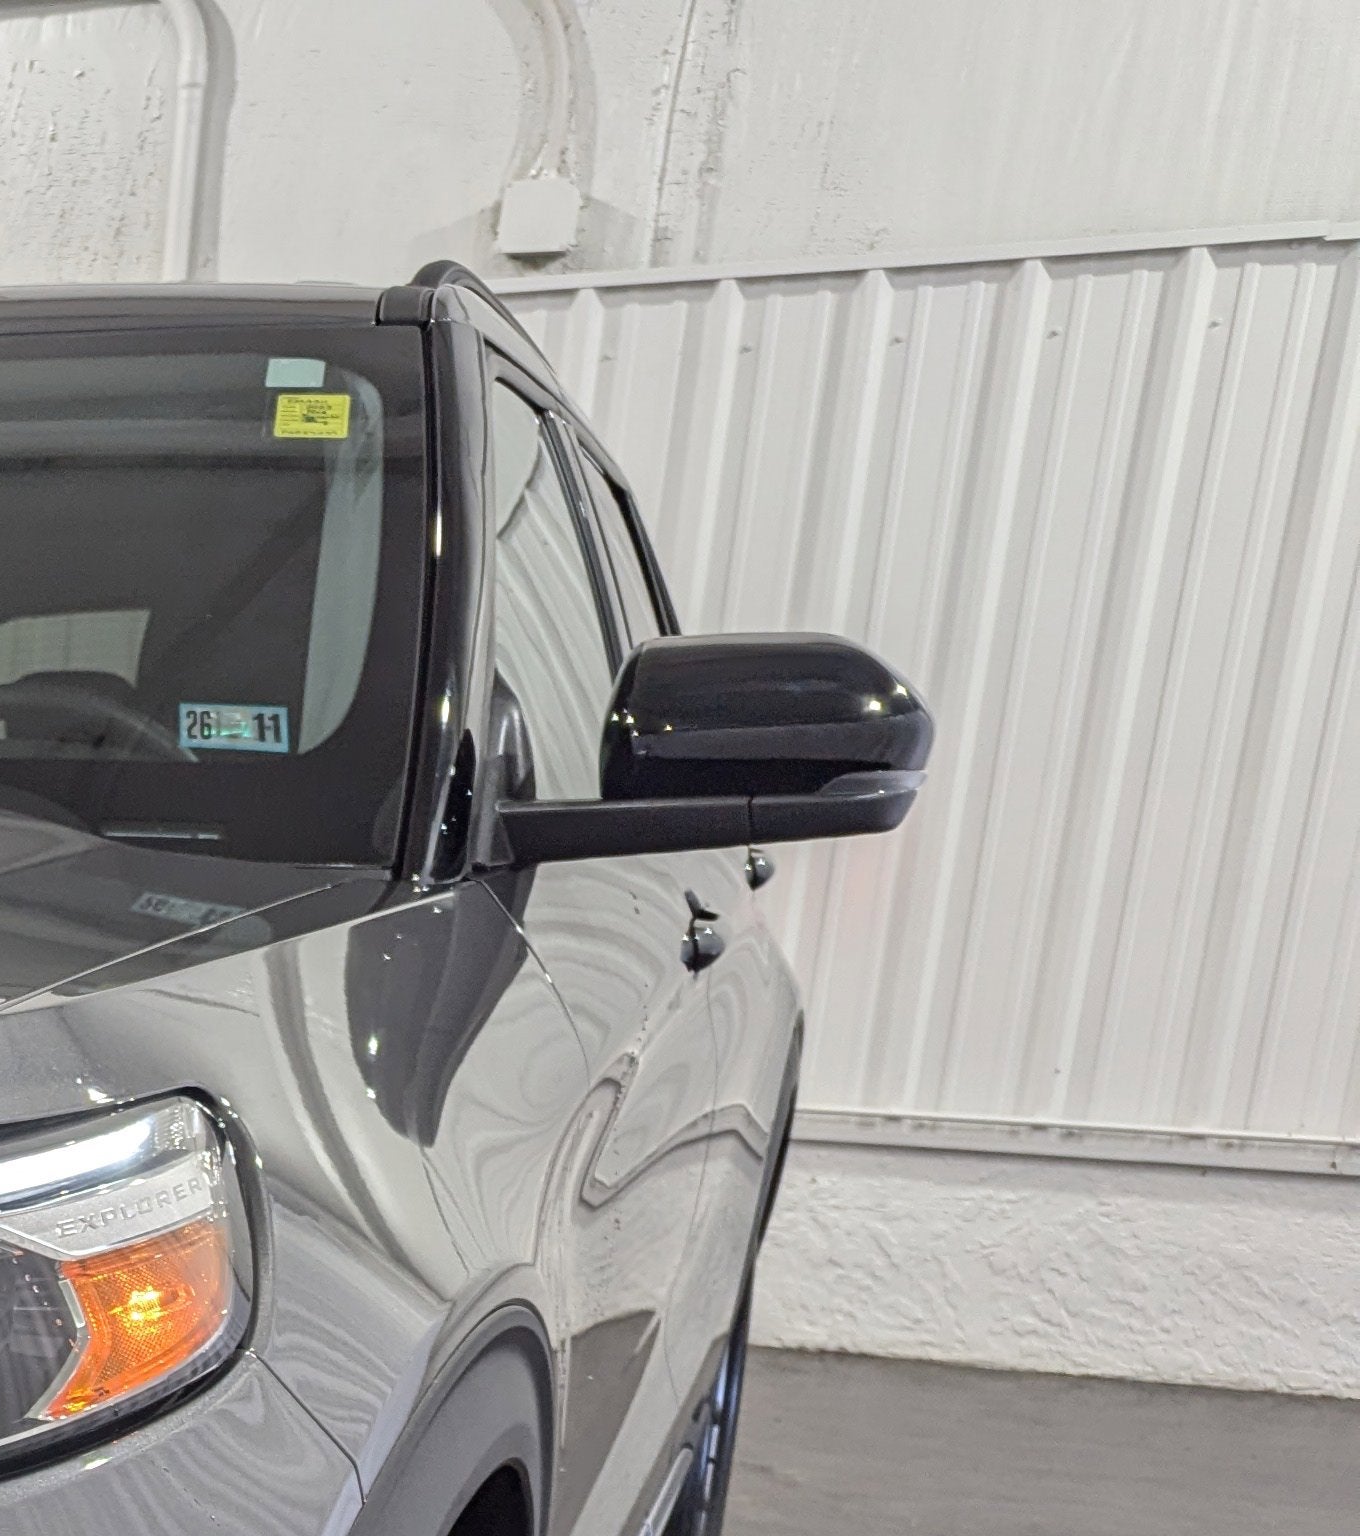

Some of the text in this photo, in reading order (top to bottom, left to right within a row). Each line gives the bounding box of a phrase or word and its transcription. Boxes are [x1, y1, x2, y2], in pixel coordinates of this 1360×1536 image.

[185, 710, 212, 740] 26
[252, 712, 281, 743] 11
[55, 1176, 203, 1239] EXPLORER
